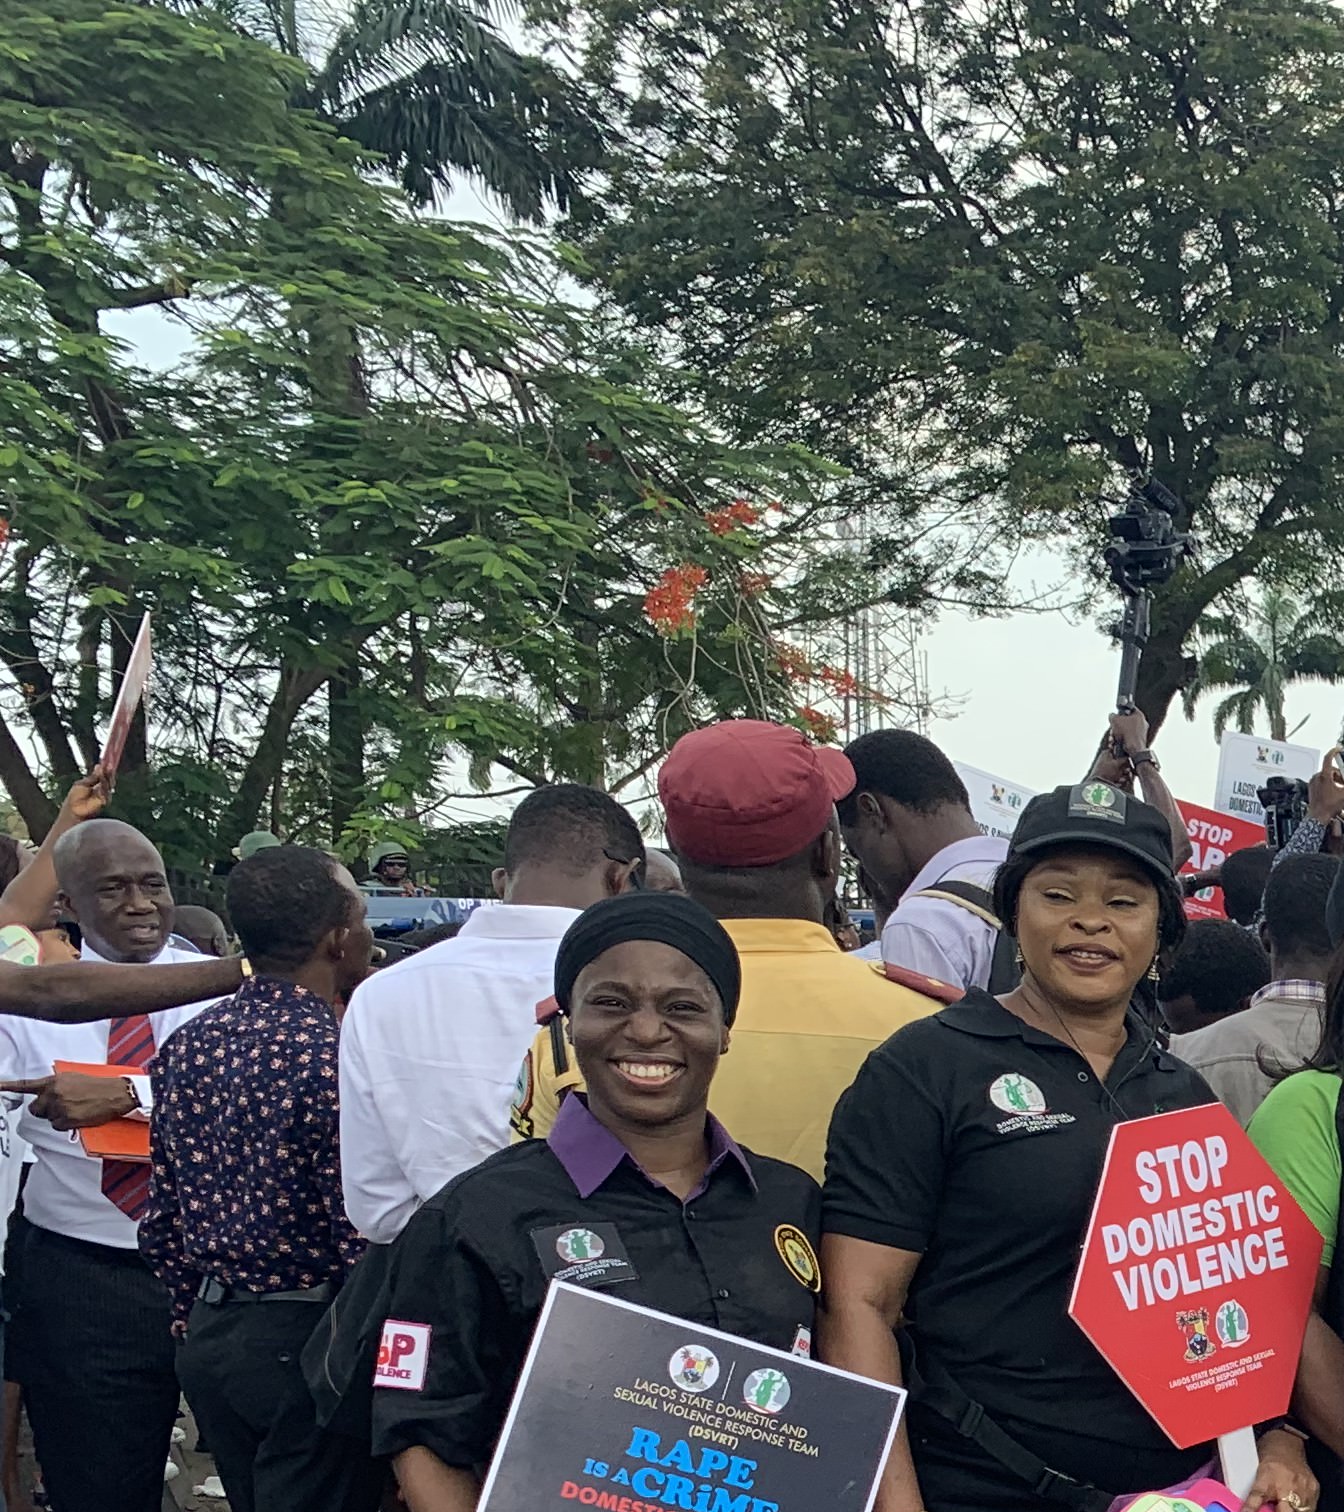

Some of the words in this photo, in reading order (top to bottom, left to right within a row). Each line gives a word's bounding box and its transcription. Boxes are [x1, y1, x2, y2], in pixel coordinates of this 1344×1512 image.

[1187, 818, 1233, 846] STOP
[1135, 1135, 1228, 1204] STOP
[1102, 1184, 1280, 1264] DOMESTIC
[1112, 1227, 1289, 1312] VIOLENCE
[613, 1387, 658, 1410] SEXUAL
[662, 1400, 722, 1428] VIOLENCE
[725, 1419, 785, 1447] RESPONSE
[787, 1438, 819, 1457] TEAM
[634, 1378, 677, 1400] LAGOS
[680, 1393, 713, 1410] STATE
[716, 1402, 779, 1430] DOMESTIC
[780, 1422, 808, 1438] AND
[688, 1425, 739, 1450] (DSVRT)
[582, 1458, 610, 1479] IS
[610, 1467, 630, 1486] A
[625, 1426, 757, 1490] RAPE
